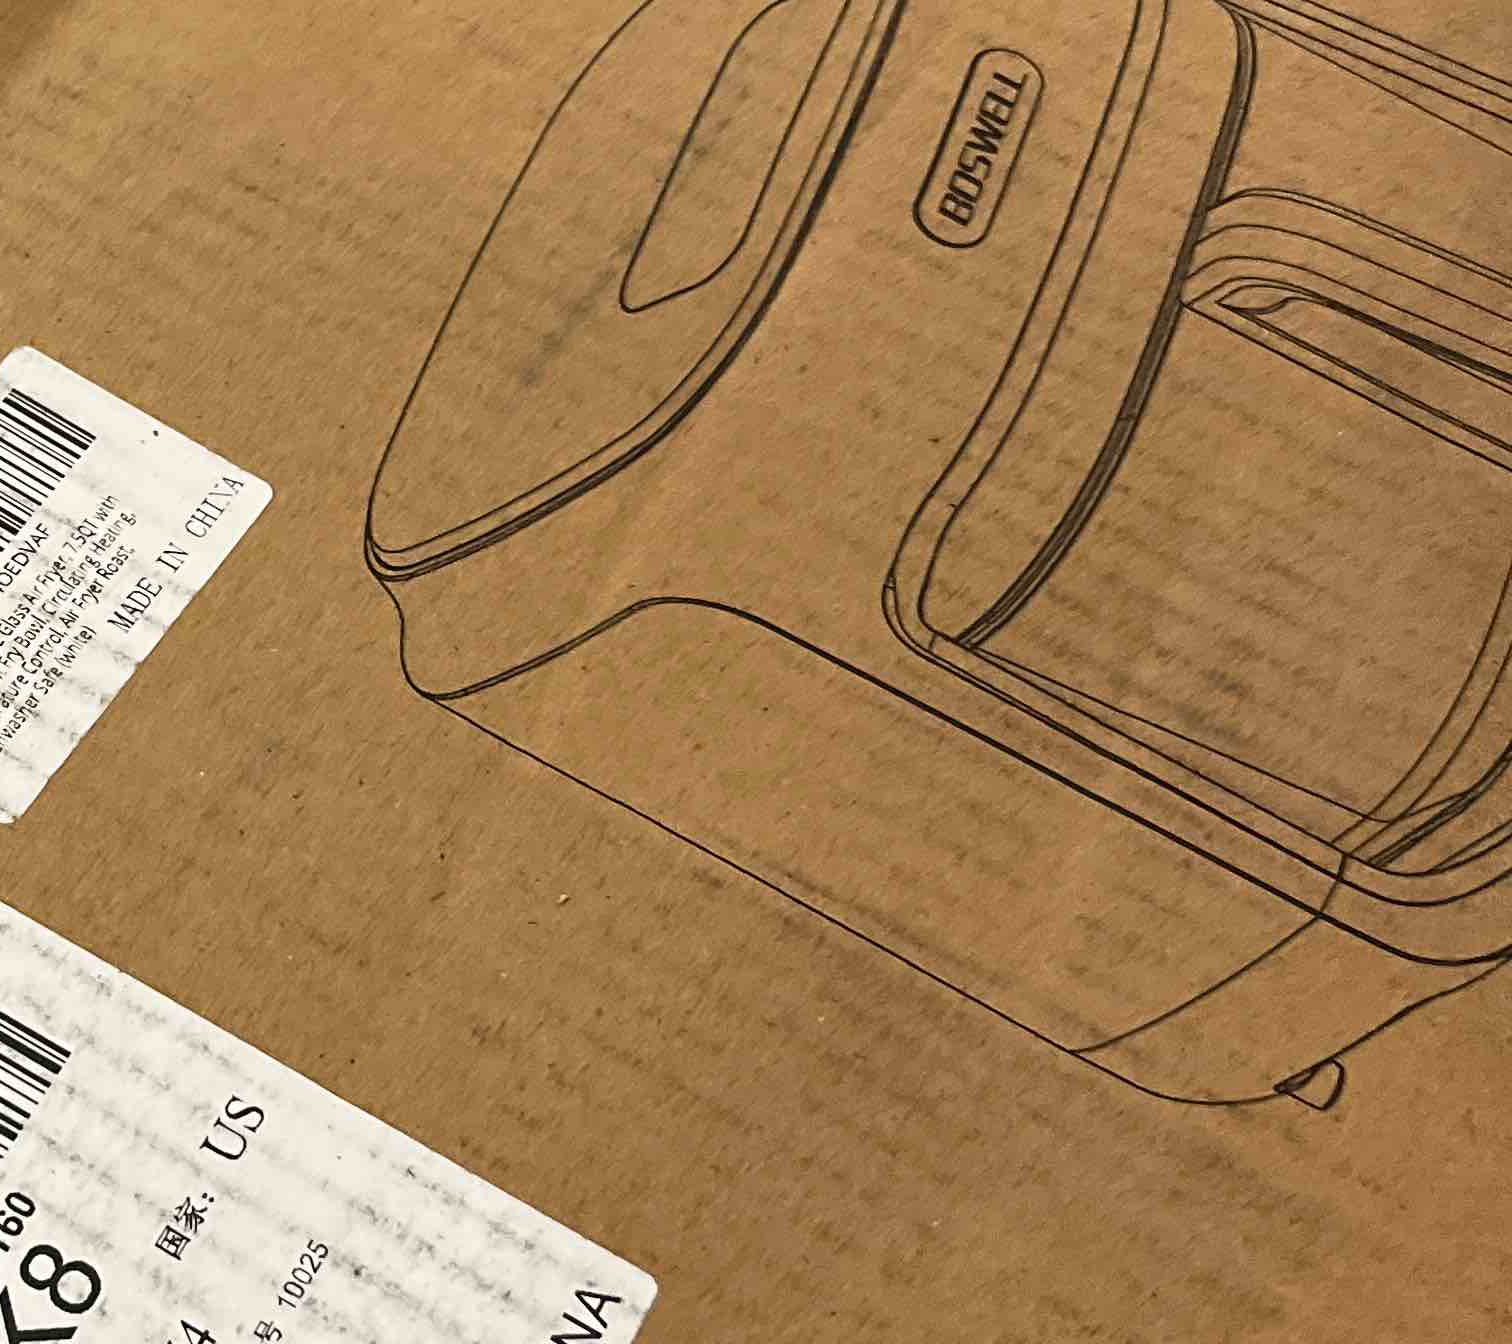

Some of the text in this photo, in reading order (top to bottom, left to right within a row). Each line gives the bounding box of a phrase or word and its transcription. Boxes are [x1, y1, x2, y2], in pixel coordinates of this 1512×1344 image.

[938, 72, 1029, 226] BOSWELL
[38, 552, 102, 618] Circulating
[106, 474, 246, 634] MADE IN CHINA
[70, 577, 108, 612] Fryer
[32, 664, 64, 696] Safe
[53, 624, 98, 669] (white)
[200, 1095, 264, 1160] US
[278, 1239, 328, 1308] 10025
